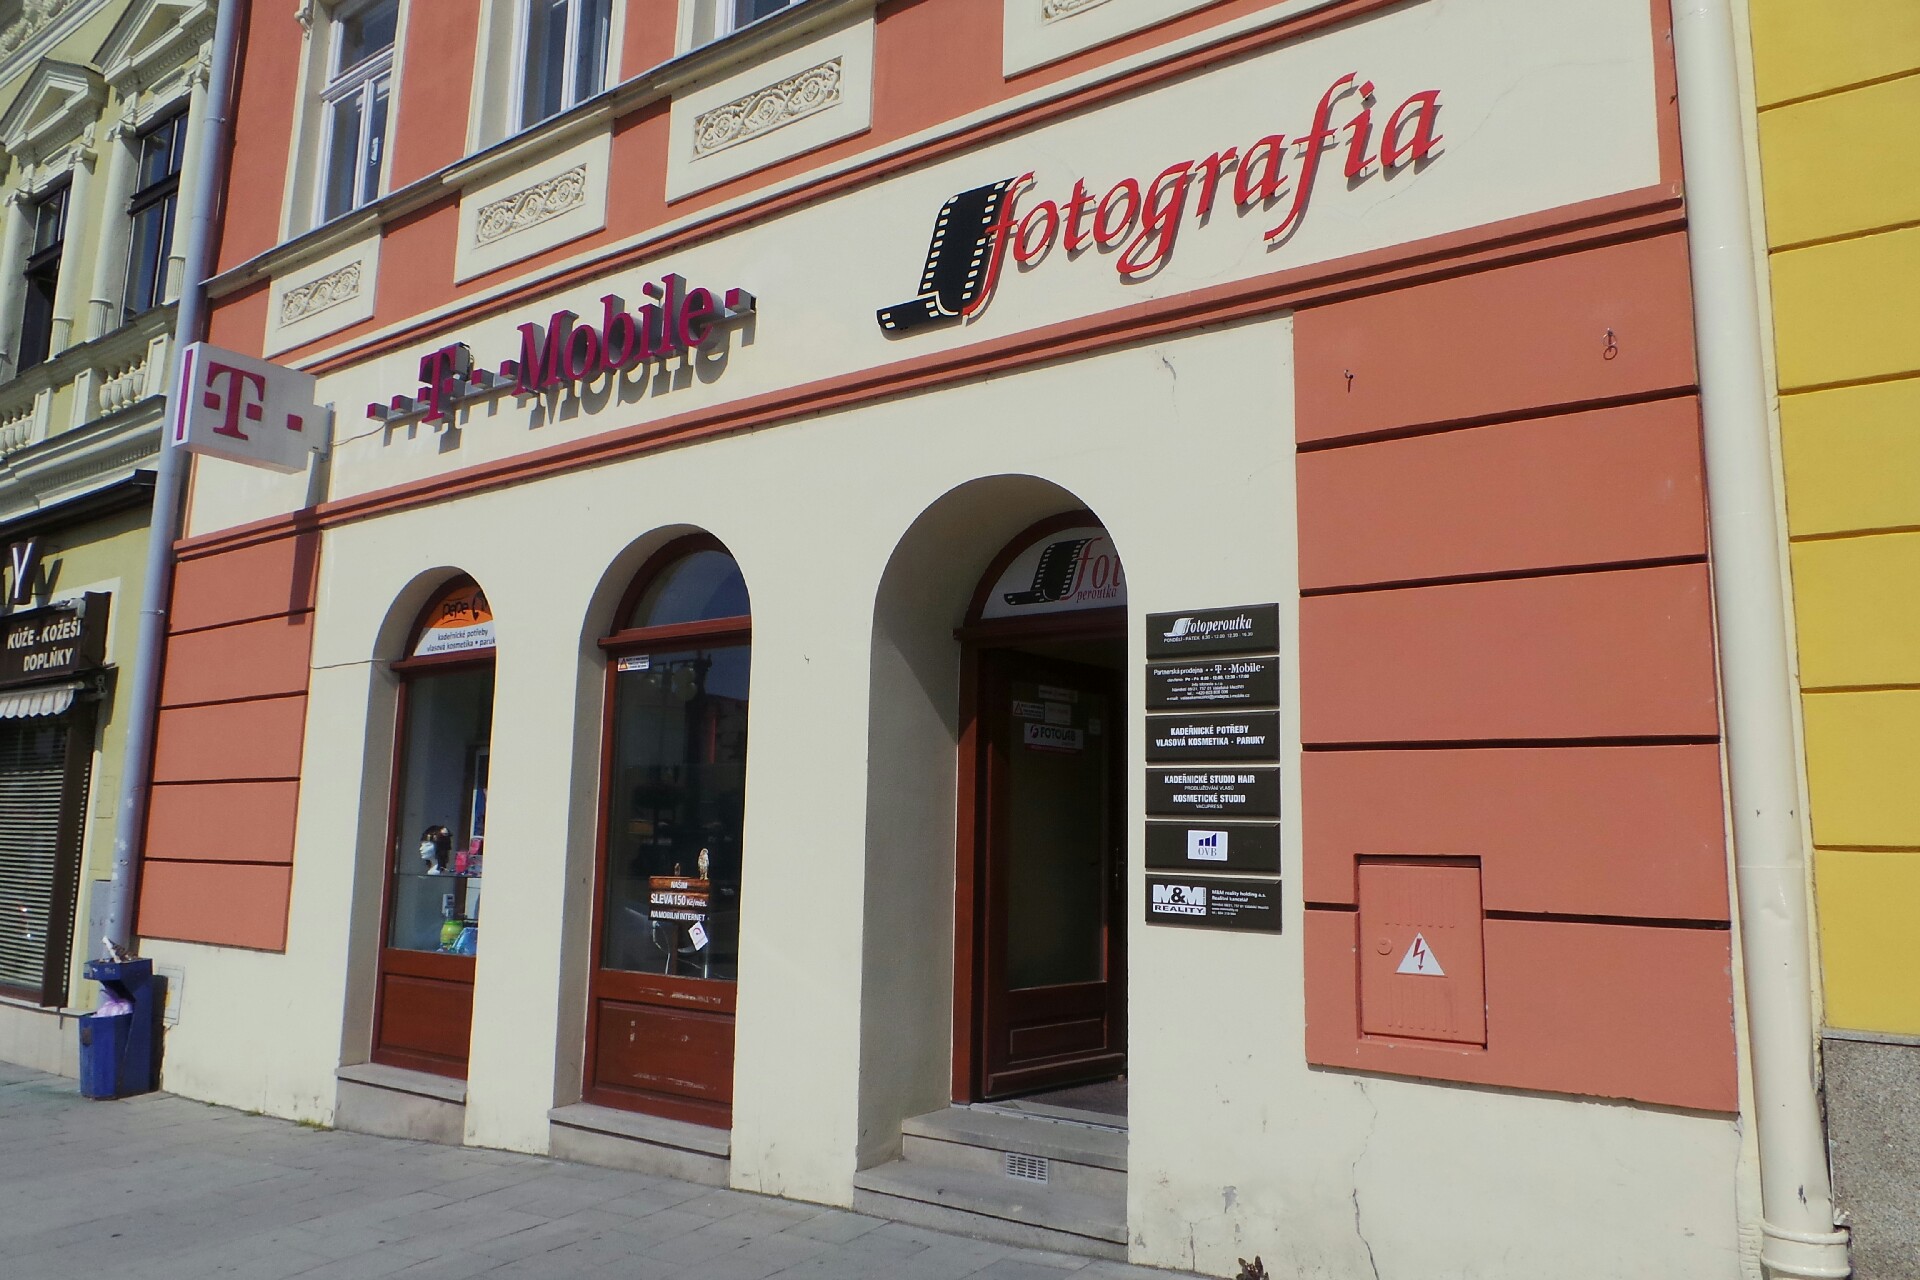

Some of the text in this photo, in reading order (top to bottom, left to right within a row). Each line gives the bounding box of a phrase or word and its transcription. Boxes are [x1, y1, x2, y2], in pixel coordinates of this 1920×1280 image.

[962, 71, 1444, 318] fotografia
[512, 273, 720, 396] Mobile
[1077, 584, 1117, 603] peroutka
[7, 626, 35, 650] KŮŽE
[438, 628, 488, 641] kadeřnické potřeby
[447, 639, 474, 650] kosmetika
[23, 647, 73, 672] DOPLŇKY
[1154, 667, 1180, 676] Partnerská
[1180, 667, 1203, 675] prodejna
[1170, 723, 1249, 736] KADEŘNICKÉ POTŘEBY
[1156, 736, 1186, 747] VLASOVÁ
[1188, 737, 1228, 746] KOSMETIKA
[1236, 735, 1265, 745] PARUKY
[1164, 773, 1255, 784] KADEŘNICKÉ STUDIO HAIR
[1173, 792, 1246, 803] KOSMETICKÉ STUDIO
[1197, 847, 1217, 857] OVB
[651, 893, 673, 905] SLEVA
[674, 895, 686, 906] 150
[1153, 884, 1205, 905] M&M
[1154, 904, 1204, 914] REALITY
